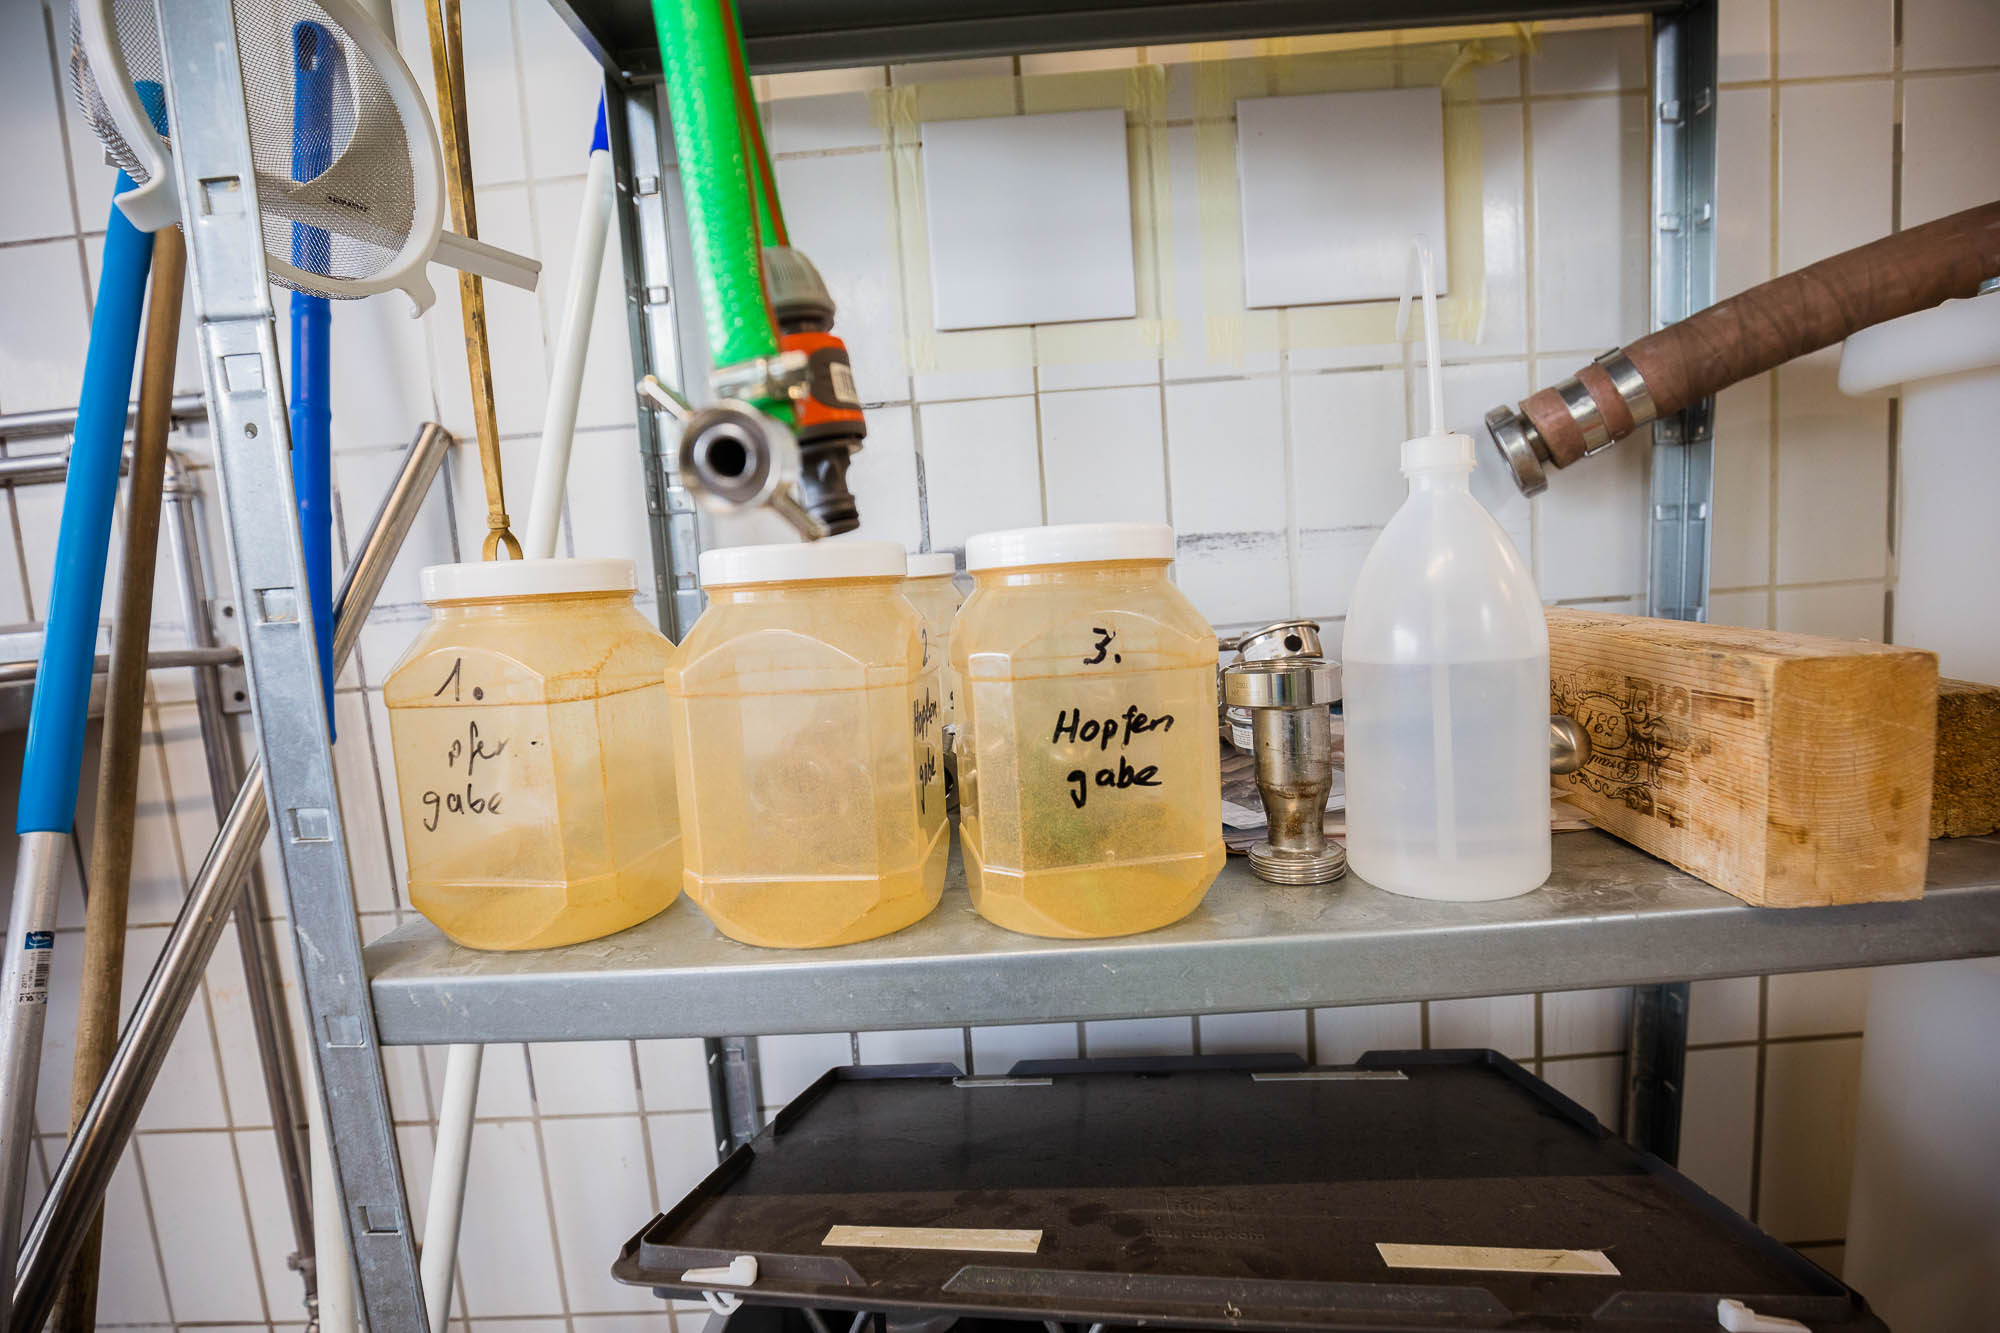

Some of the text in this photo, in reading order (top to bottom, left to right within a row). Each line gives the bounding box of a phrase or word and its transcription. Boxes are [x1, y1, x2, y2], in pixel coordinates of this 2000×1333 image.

[1083, 627, 1122, 665] 3.
[434, 657, 484, 702] 1.
[1052, 704, 1175, 752] Hopfen
[1066, 754, 1163, 809] gabe
[422, 783, 504, 832] gabe
